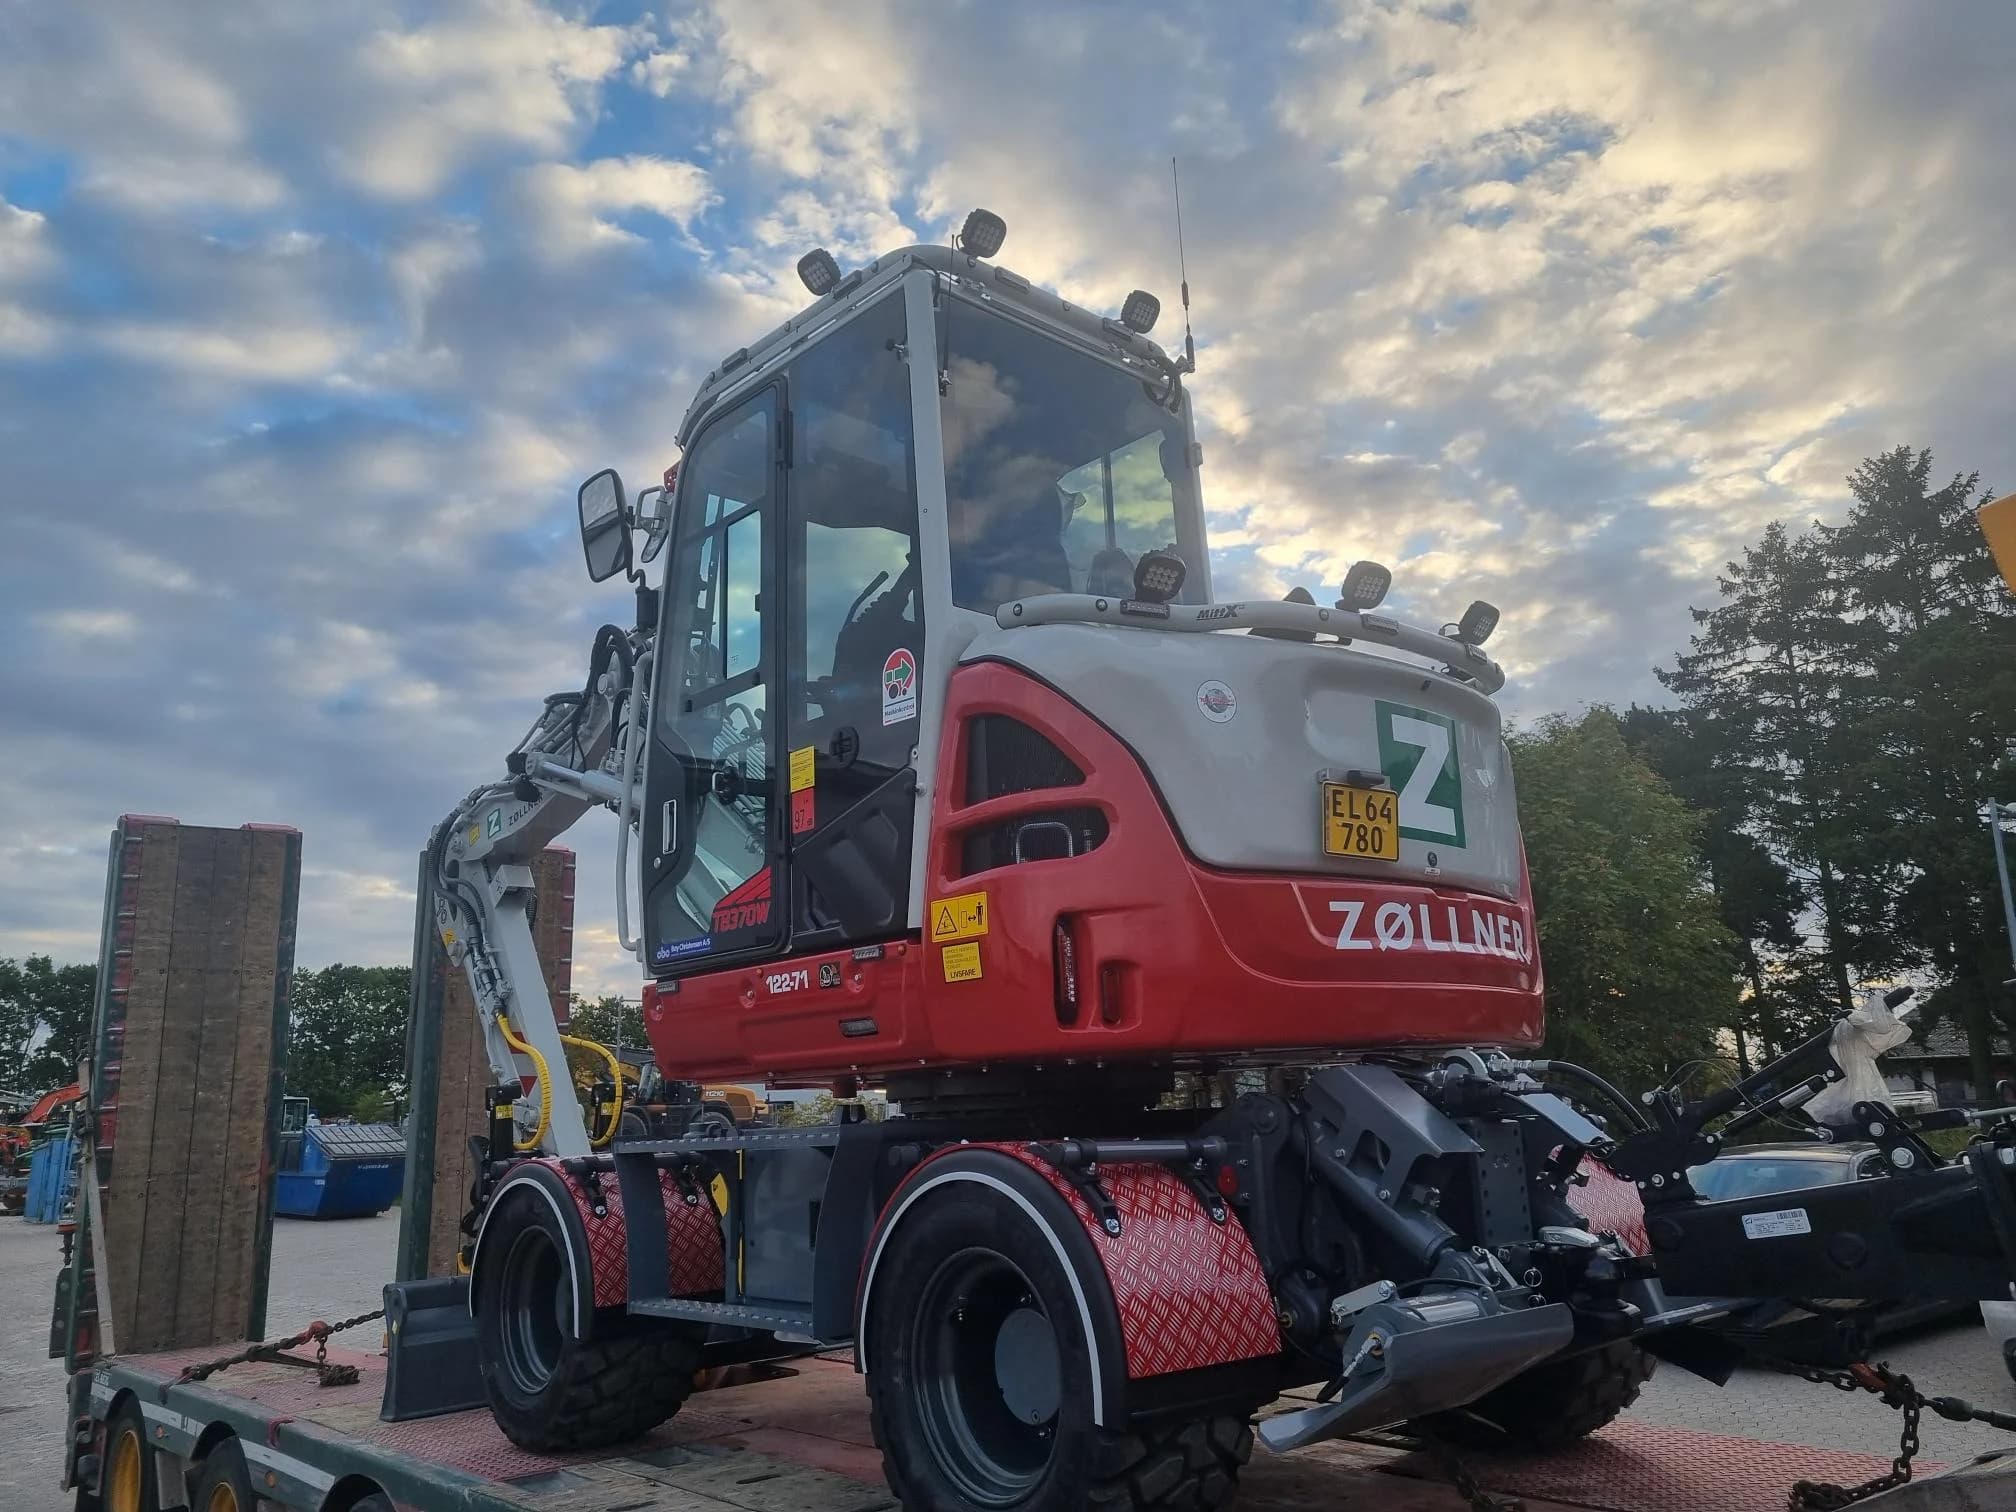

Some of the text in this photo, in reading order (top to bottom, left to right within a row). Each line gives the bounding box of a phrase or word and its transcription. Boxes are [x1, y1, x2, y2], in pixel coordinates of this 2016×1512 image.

[1391, 714, 1457, 837] Z
[794, 809, 805, 830] 97
[1341, 823, 1384, 855] 780
[713, 900, 772, 934] TB370W
[1329, 900, 1532, 965] ZØLLNER
[765, 969, 809, 995] 122-71
